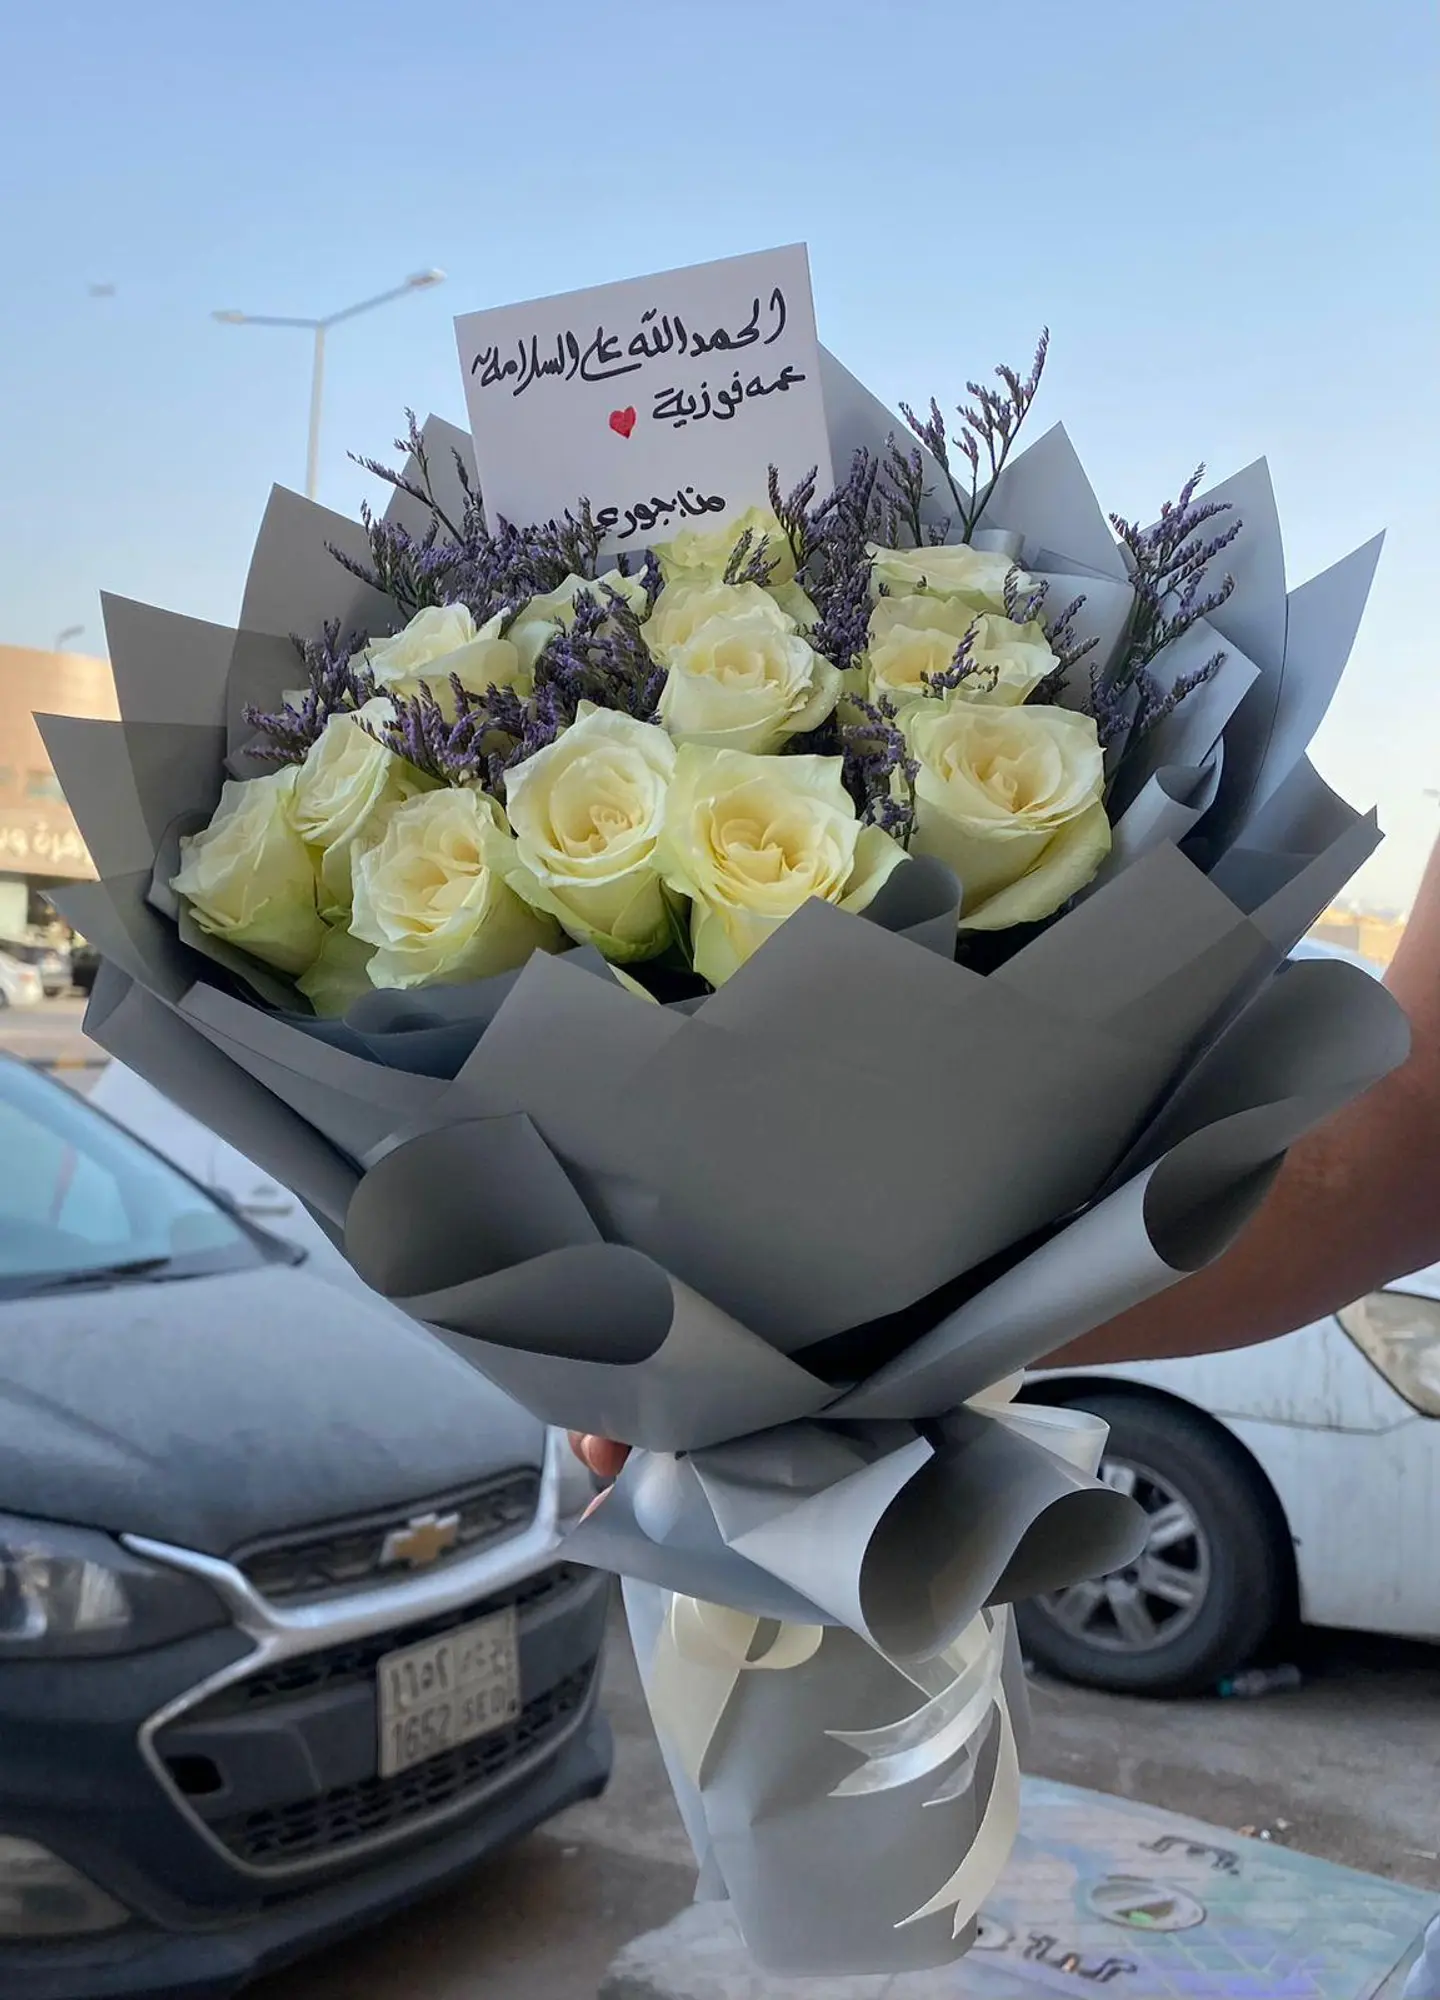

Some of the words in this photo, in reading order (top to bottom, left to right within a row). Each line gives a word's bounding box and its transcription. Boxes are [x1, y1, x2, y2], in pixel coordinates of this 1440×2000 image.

[689, 286, 787, 358] الحمد
[580, 325, 642, 382] على
[652, 370, 744, 429] فوزية
